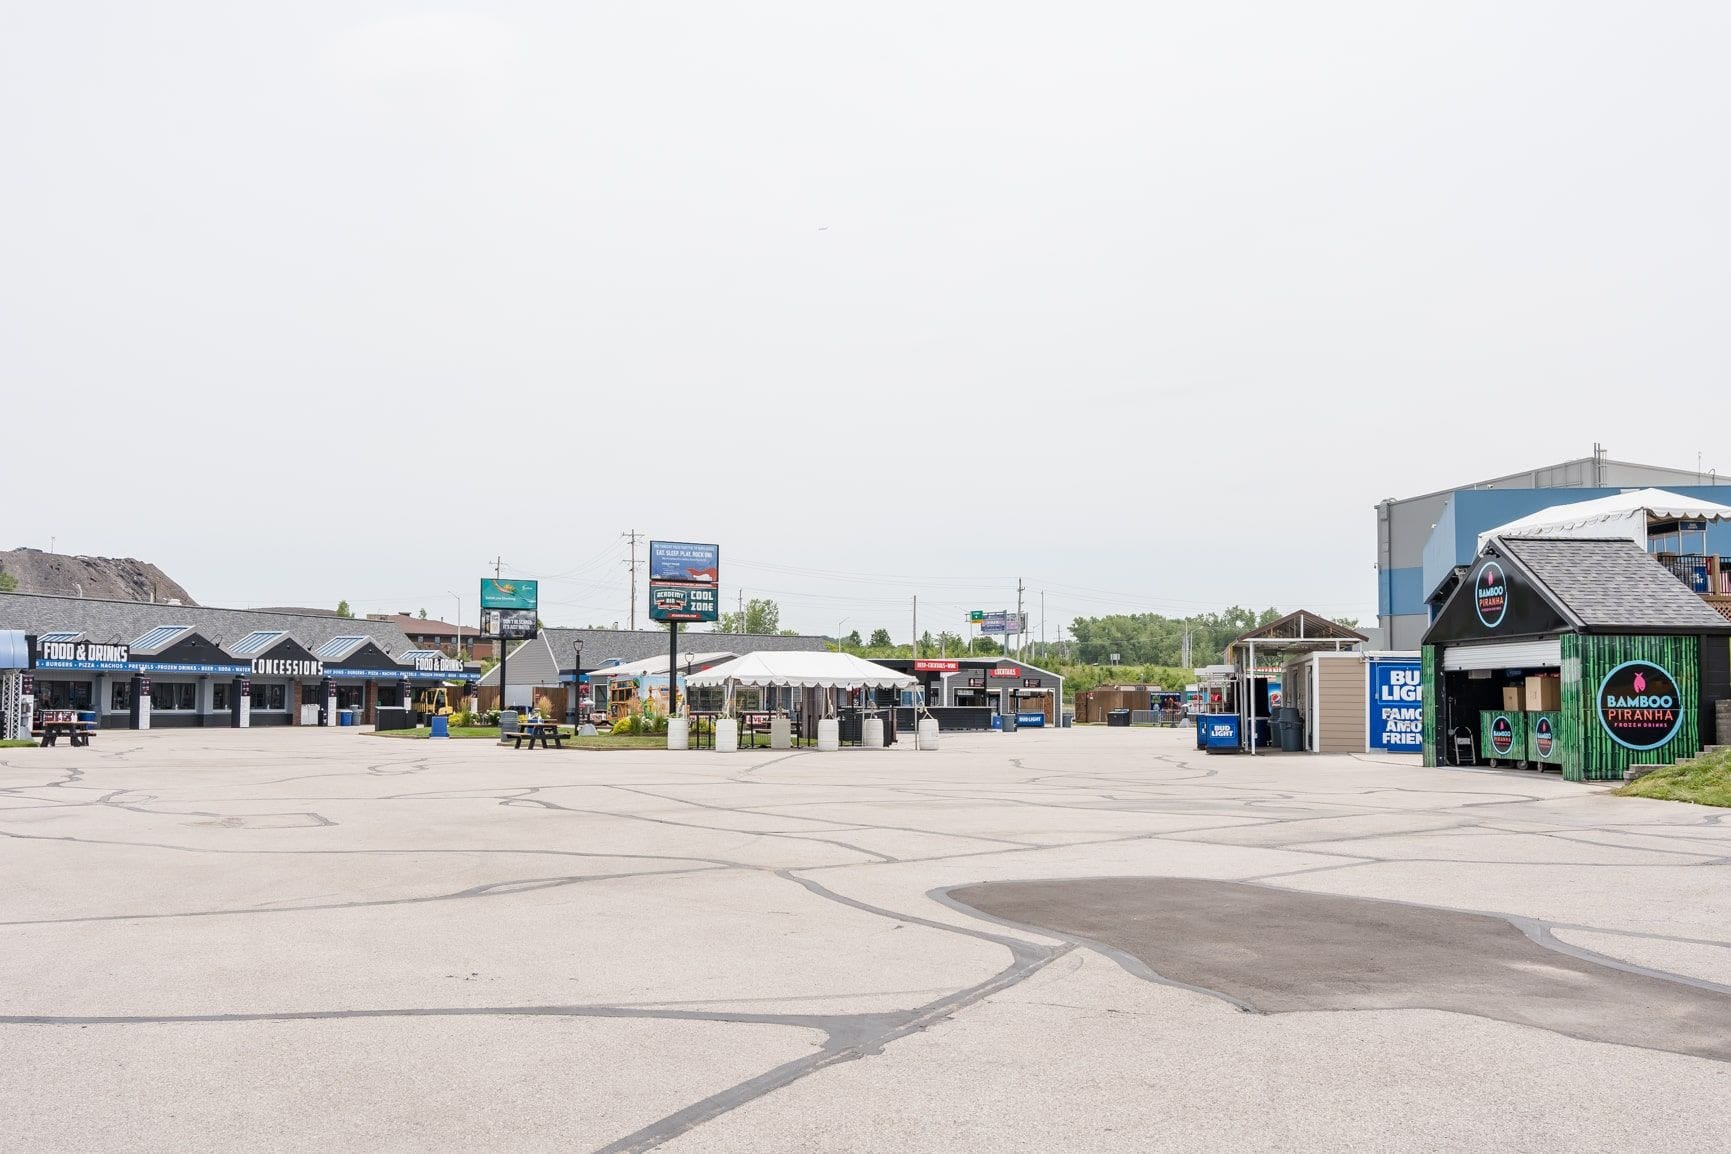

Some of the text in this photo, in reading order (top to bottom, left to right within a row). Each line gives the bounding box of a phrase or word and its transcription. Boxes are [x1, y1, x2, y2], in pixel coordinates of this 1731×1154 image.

[691, 591, 714, 601] COOL
[1479, 586, 1504, 598] BAMBOO
[691, 602, 714, 612] ZONE
[1479, 596, 1504, 607] PIRANHA
[44, 642, 128, 662] FOOD & DRINKS
[252, 659, 323, 675] CONCESSIONS
[415, 658, 464, 672] FOOD & DRINKS
[1607, 695, 1672, 708] BAMBOO
[1608, 709, 1674, 721] PIRANHA
